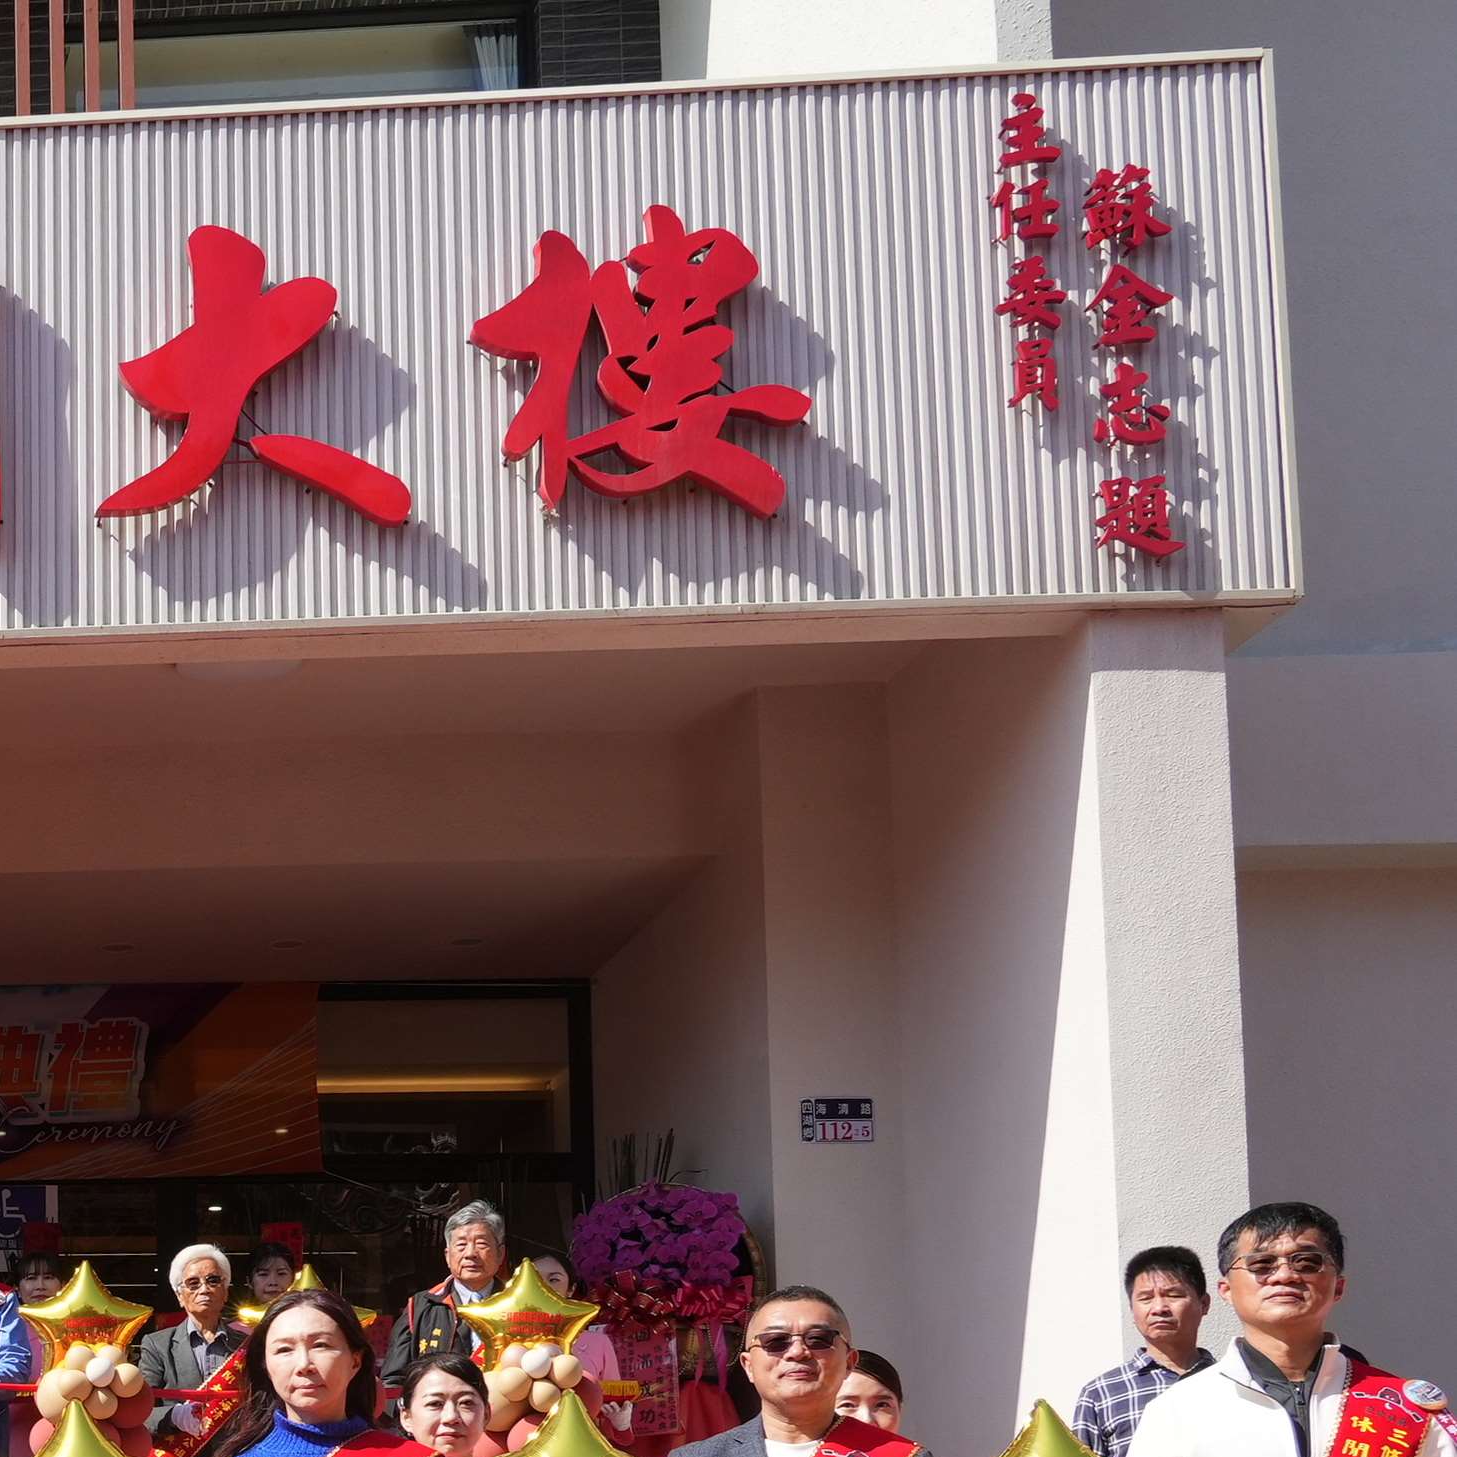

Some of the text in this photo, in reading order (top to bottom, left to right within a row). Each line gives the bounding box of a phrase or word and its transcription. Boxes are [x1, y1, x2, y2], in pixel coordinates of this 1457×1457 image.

[992, 92, 1067, 411] 主任委員
[1084, 163, 1185, 557] 蘇金志題
